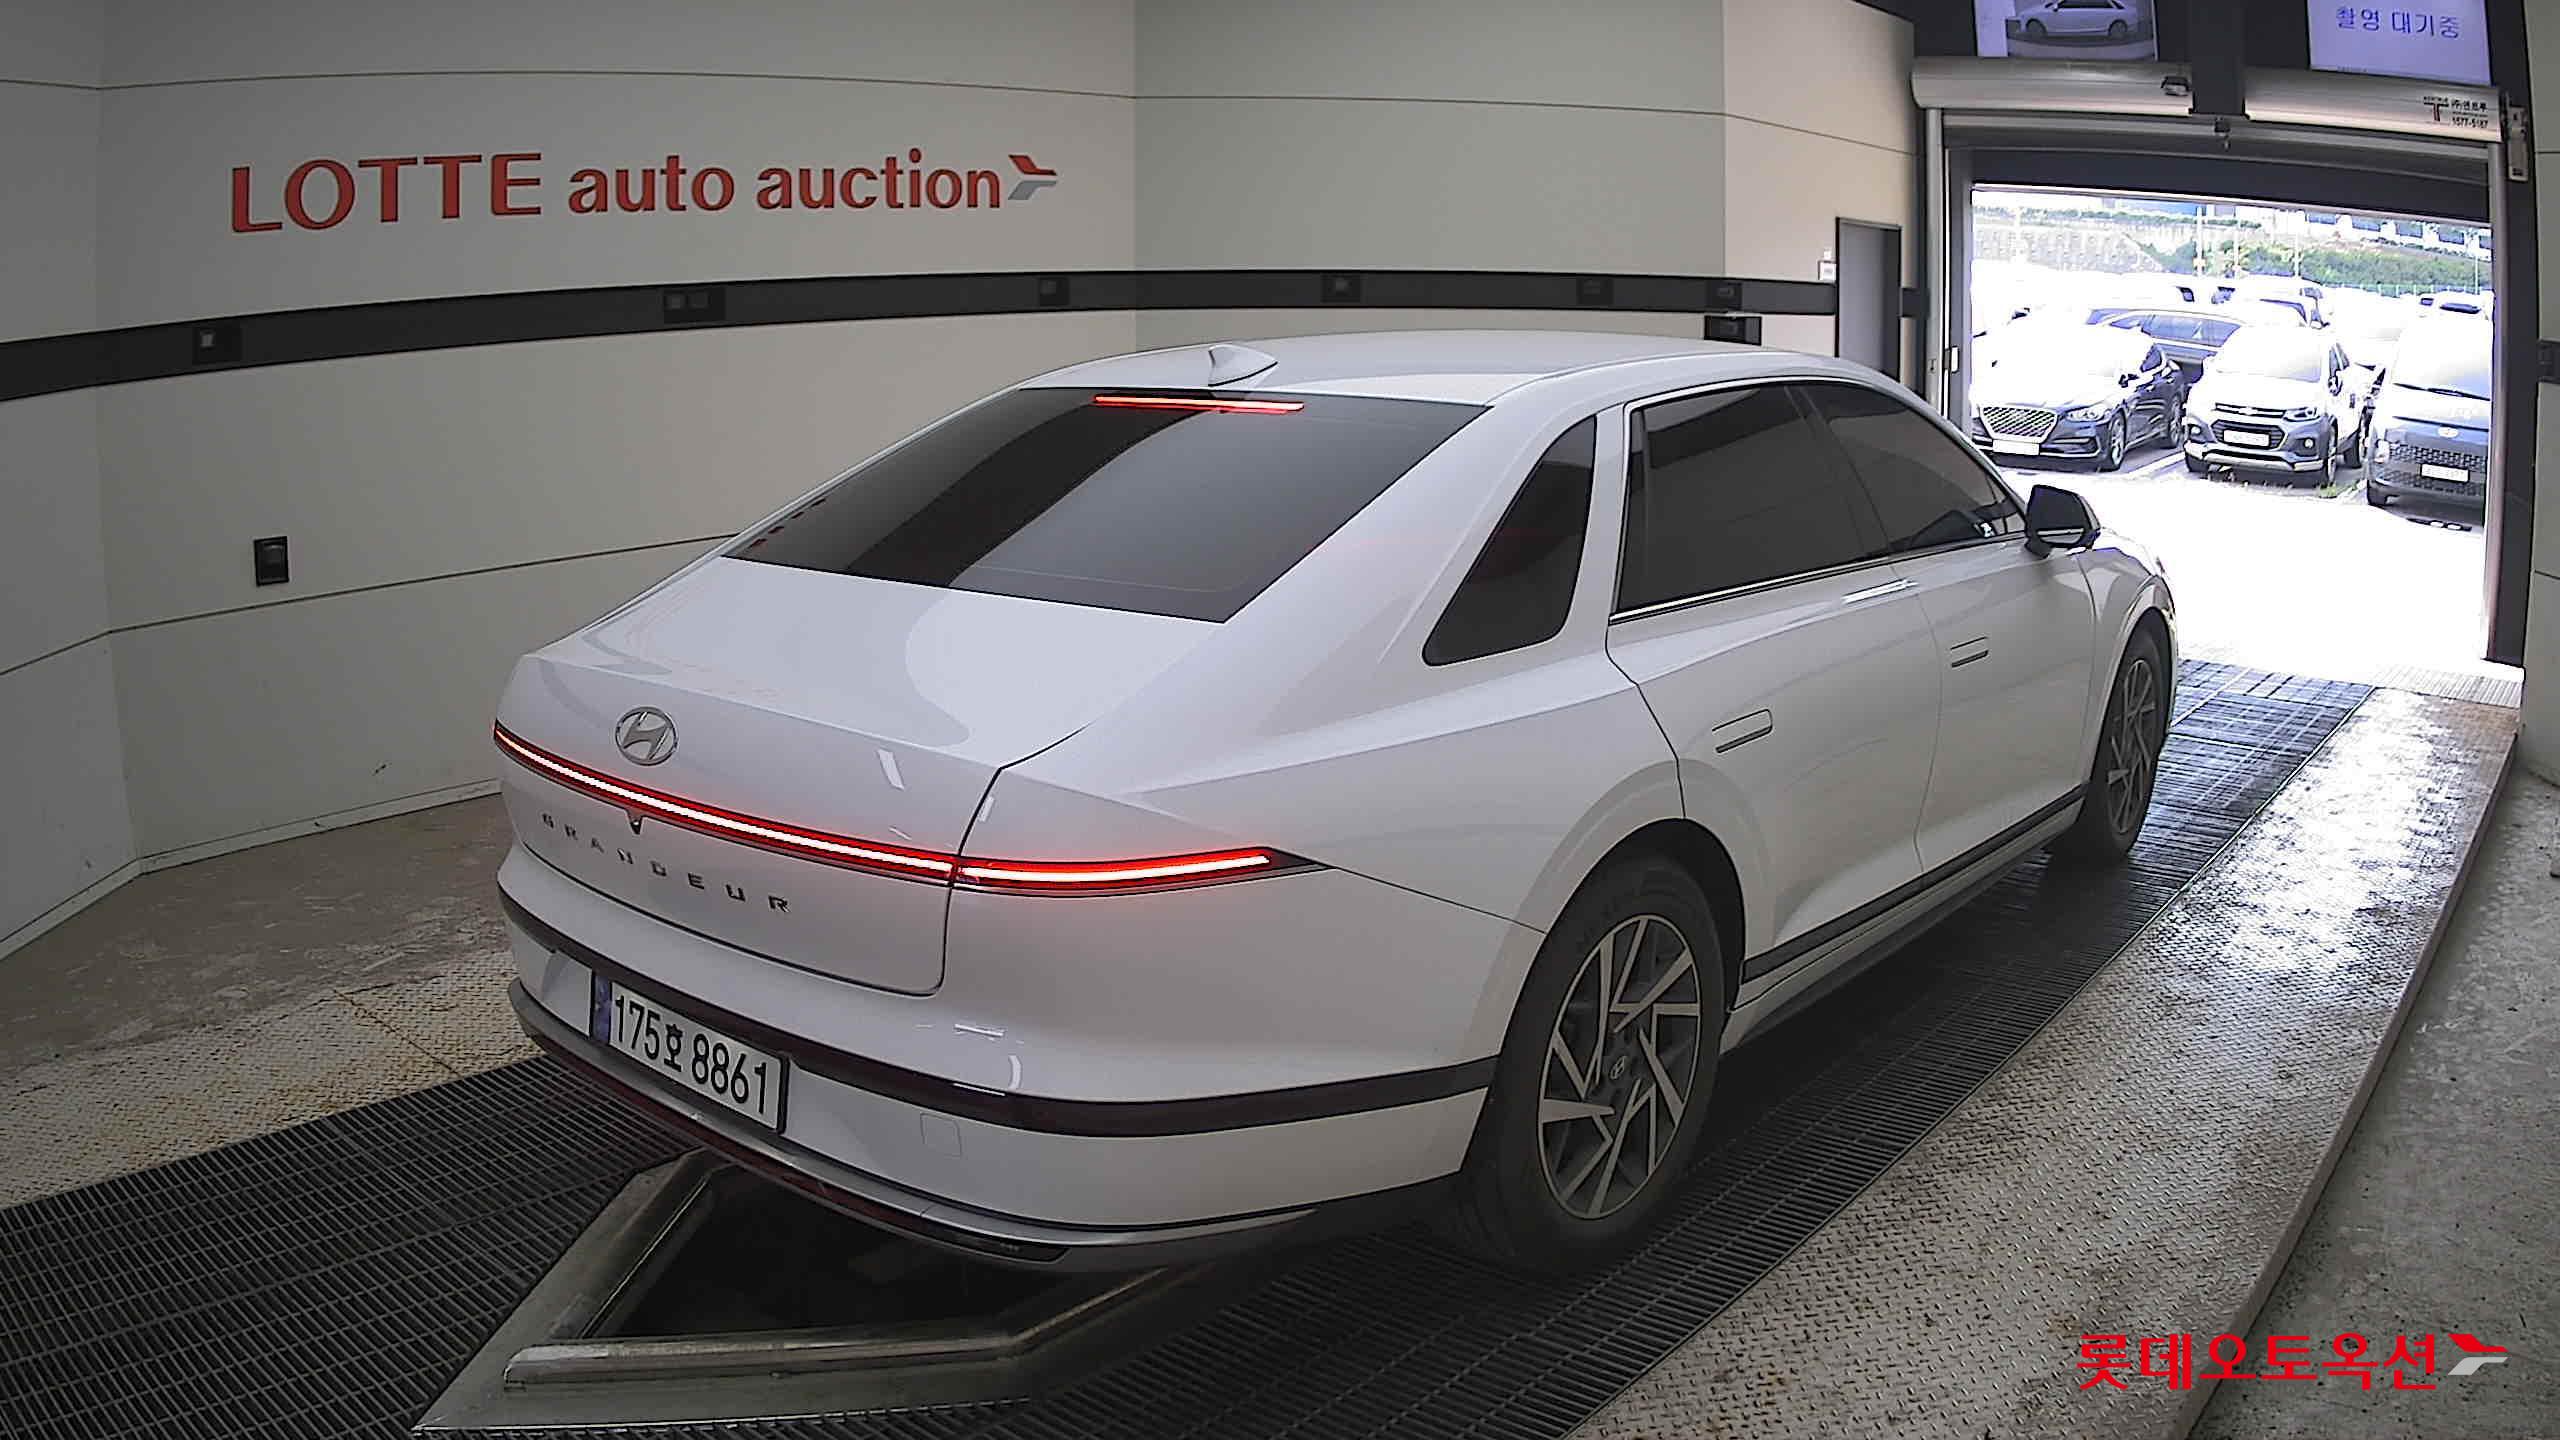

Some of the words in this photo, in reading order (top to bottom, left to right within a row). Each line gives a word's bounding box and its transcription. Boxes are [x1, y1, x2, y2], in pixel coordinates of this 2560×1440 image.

[2336, 6, 2380, 31] 촬영
[2391, 11, 2460, 39] 대기중
[232, 152, 542, 233] LOTTE
[568, 154, 736, 213] auto
[757, 147, 1001, 210] auction
[541, 811, 791, 914] GRANDEUR
[614, 995, 684, 1073] 175호
[691, 1032, 768, 1115] 8861
